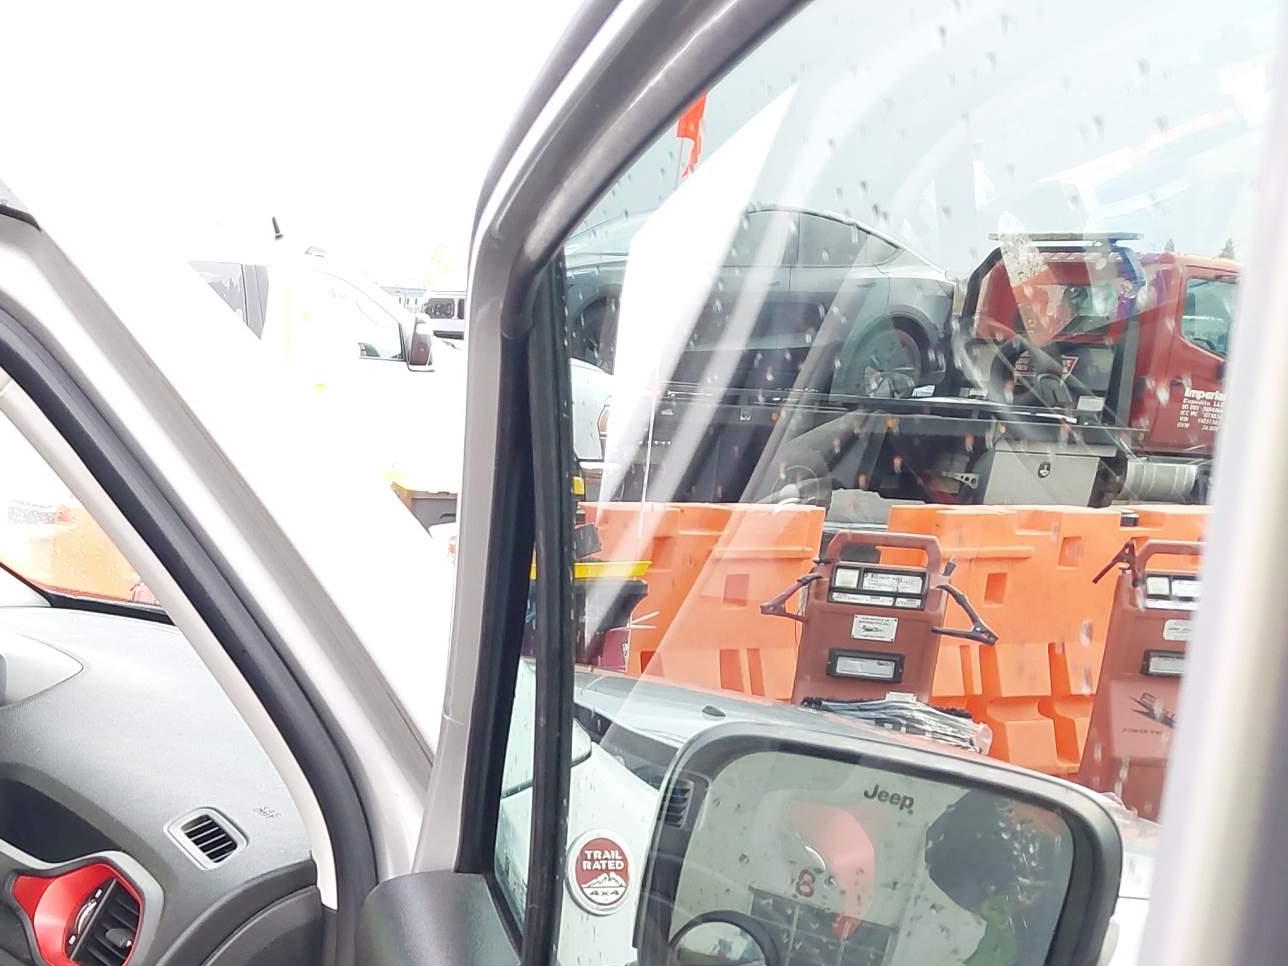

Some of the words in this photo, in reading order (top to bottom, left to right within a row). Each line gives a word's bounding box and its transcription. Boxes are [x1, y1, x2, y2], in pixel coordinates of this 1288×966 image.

[863, 784, 914, 811] Jeep
[584, 850, 622, 860] TRAIL
[582, 860, 625, 870] RATED
